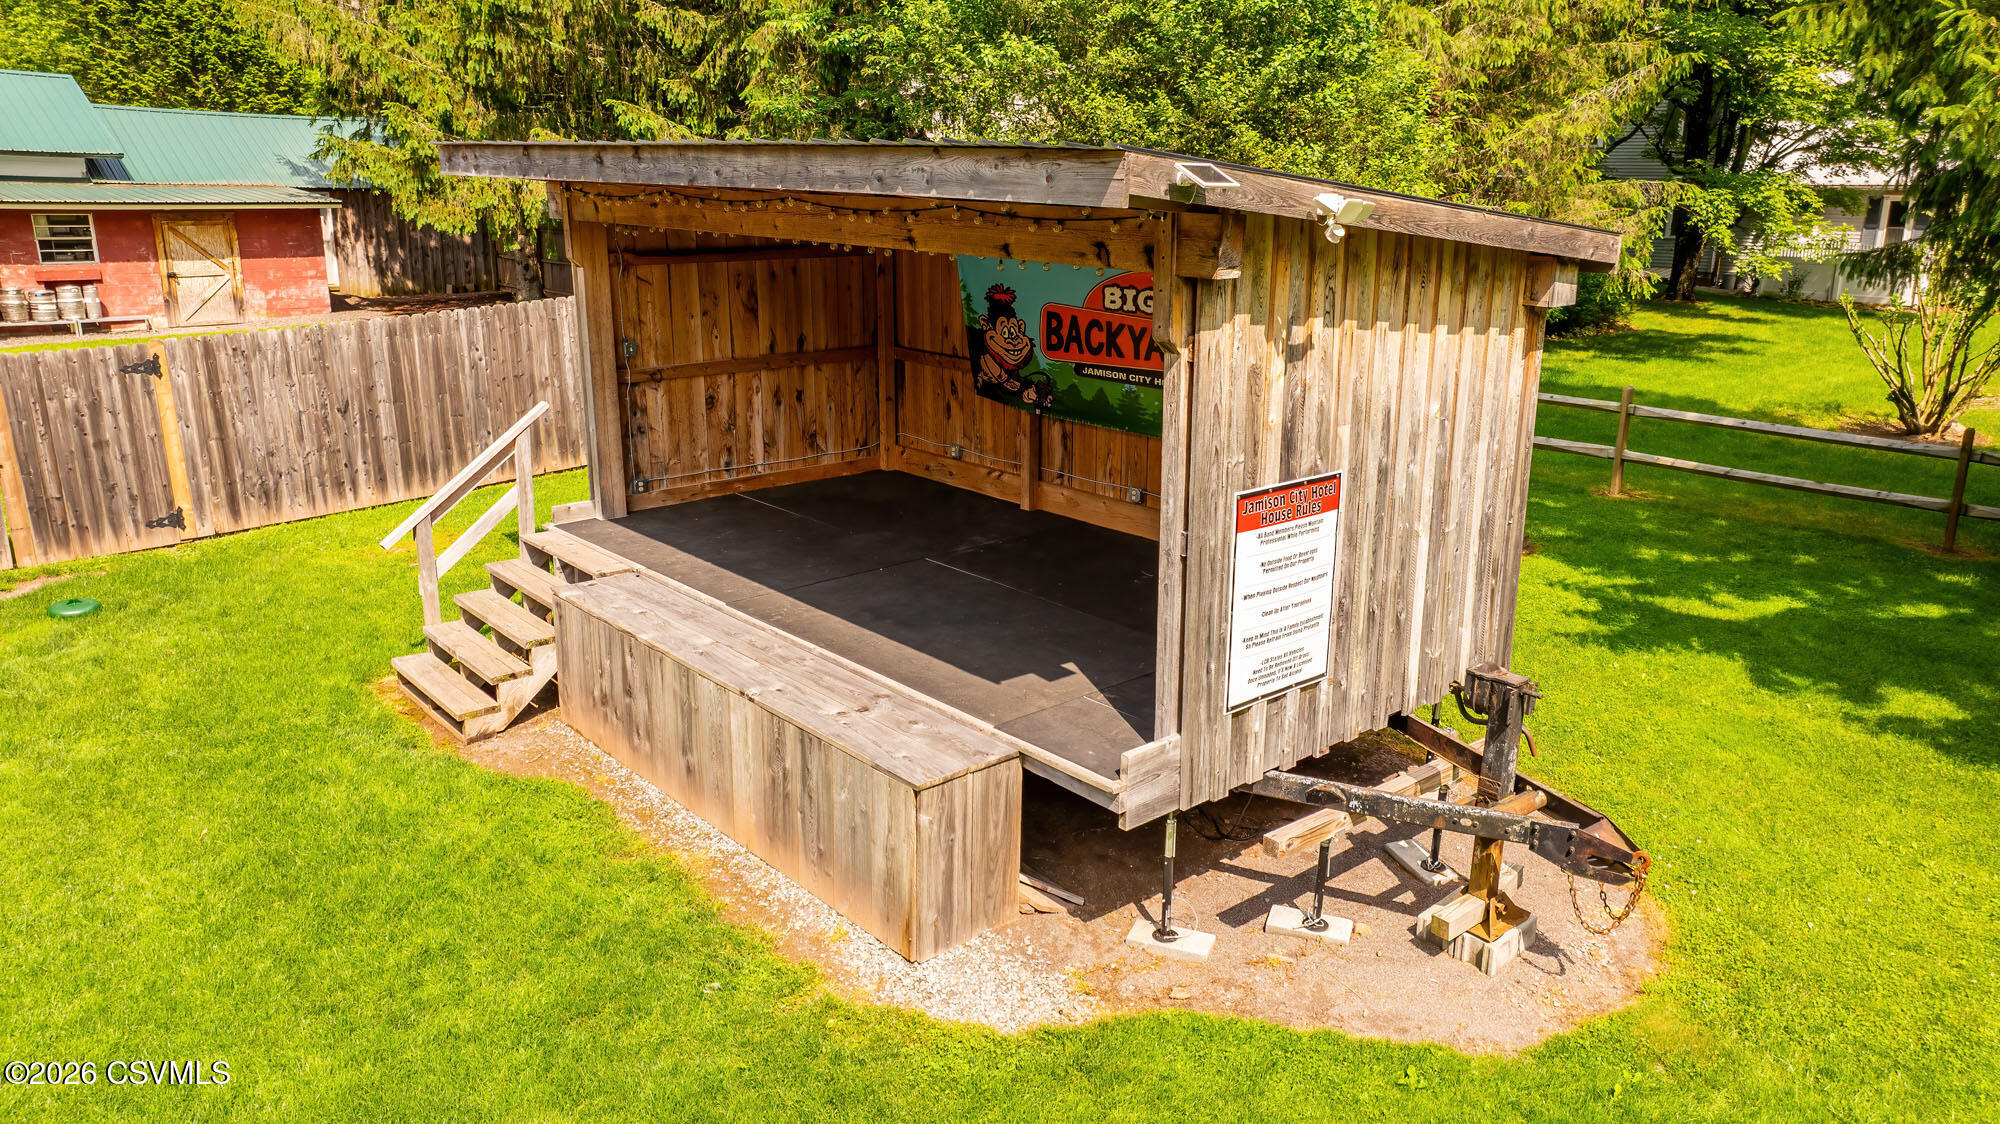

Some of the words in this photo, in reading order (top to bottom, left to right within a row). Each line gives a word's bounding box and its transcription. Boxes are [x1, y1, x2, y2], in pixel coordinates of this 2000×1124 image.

[1082, 367, 1127, 380] JAMISON
[1129, 374, 1152, 384] CITY
[1242, 494, 1286, 515] Jamison
[1289, 488, 1308, 505] City
[1311, 480, 1336, 499] Hotel
[1261, 508, 1292, 526] House
[1296, 500, 1321, 517] Rules
[1260, 535, 1286, 545] Professional
[1267, 558, 1282, 566] Outside
[1263, 564, 1283, 574] Permitted
[1256, 589, 1272, 597] Playing
[1273, 585, 1288, 593] Outside
[1288, 580, 1303, 589] Respect
[1252, 640, 1266, 648] Please
